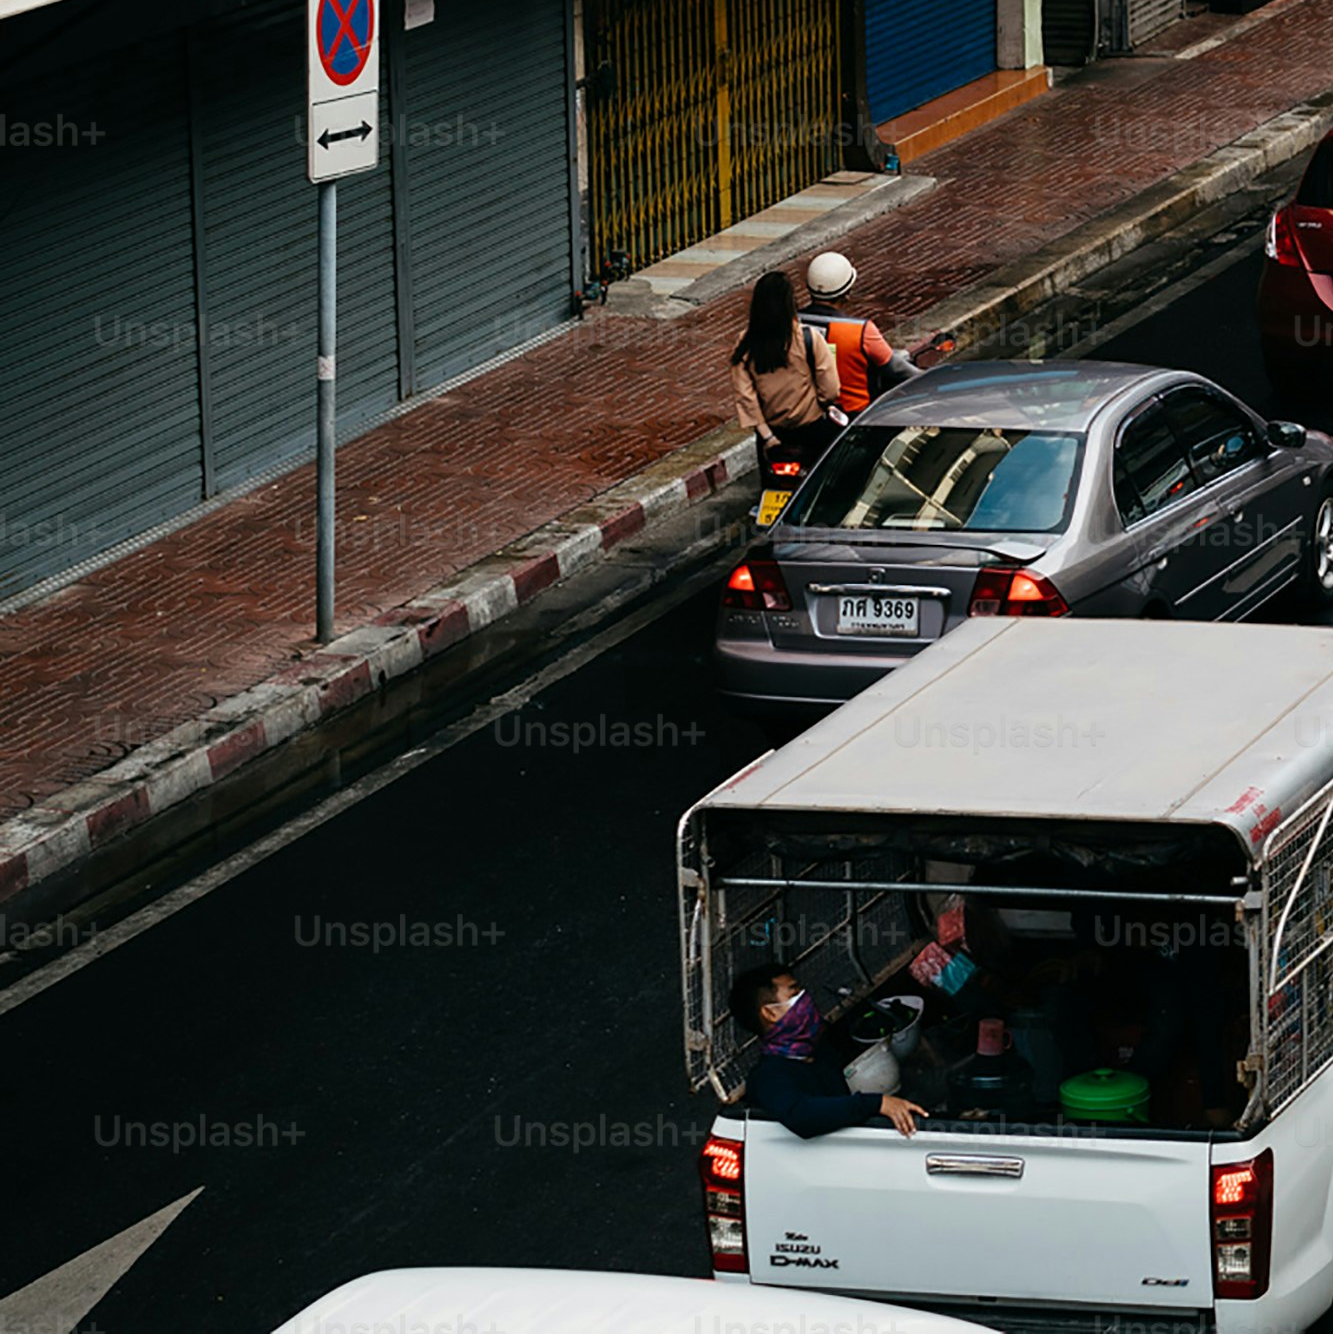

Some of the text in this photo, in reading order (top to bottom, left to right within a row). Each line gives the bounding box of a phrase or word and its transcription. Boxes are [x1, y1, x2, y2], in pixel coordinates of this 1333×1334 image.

[872, 598, 915, 620] 9369
[775, 1243, 821, 1255] ISUZU
[769, 1255, 840, 1269] D-MAX
